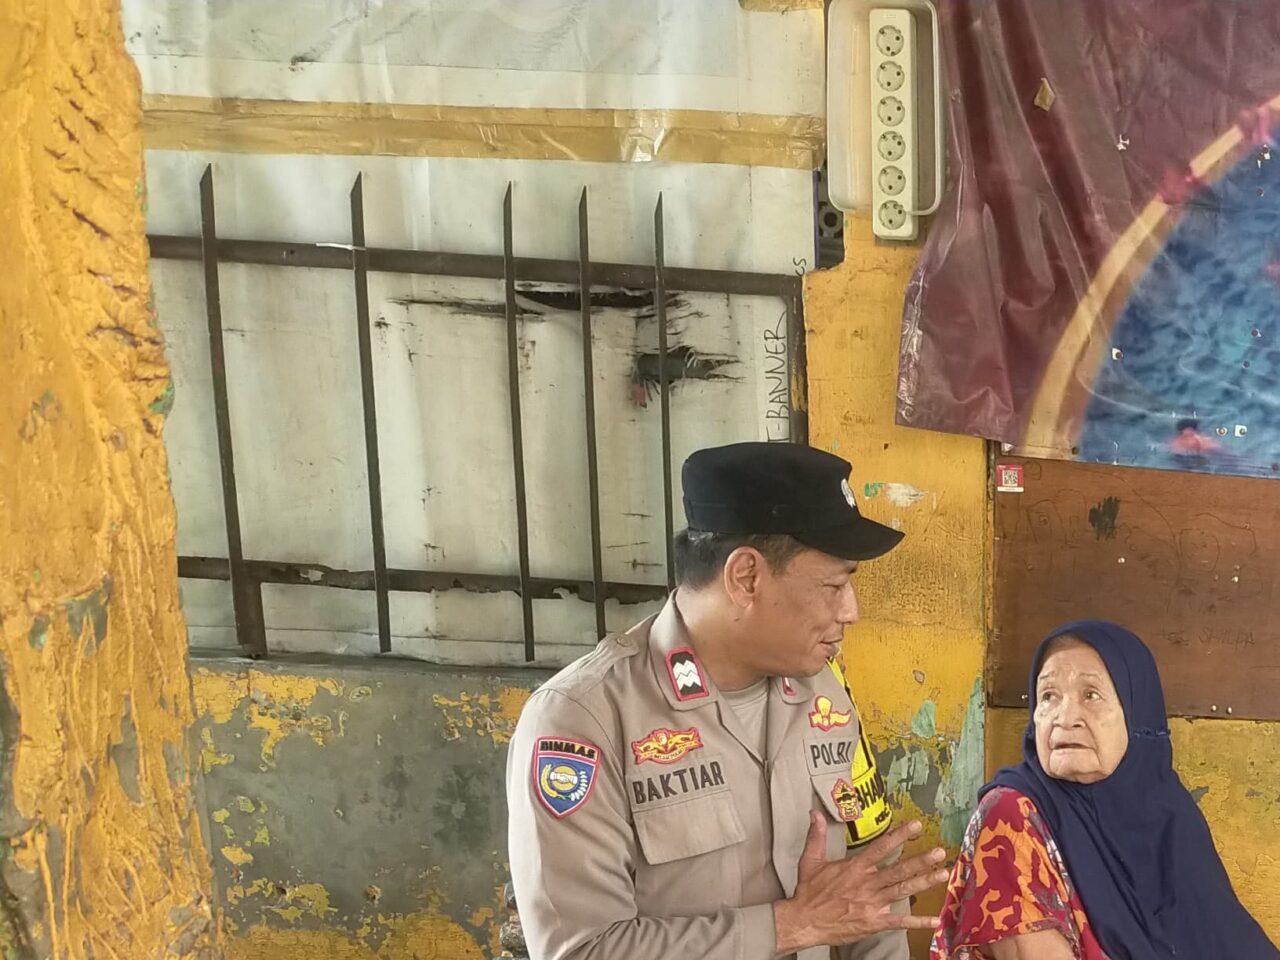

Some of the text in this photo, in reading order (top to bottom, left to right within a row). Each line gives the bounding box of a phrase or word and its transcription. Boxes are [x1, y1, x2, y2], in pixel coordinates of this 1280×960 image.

[540, 740, 597, 760] BINMAS
[809, 741, 852, 769] POLRI
[632, 760, 725, 805] BAKTIAR
